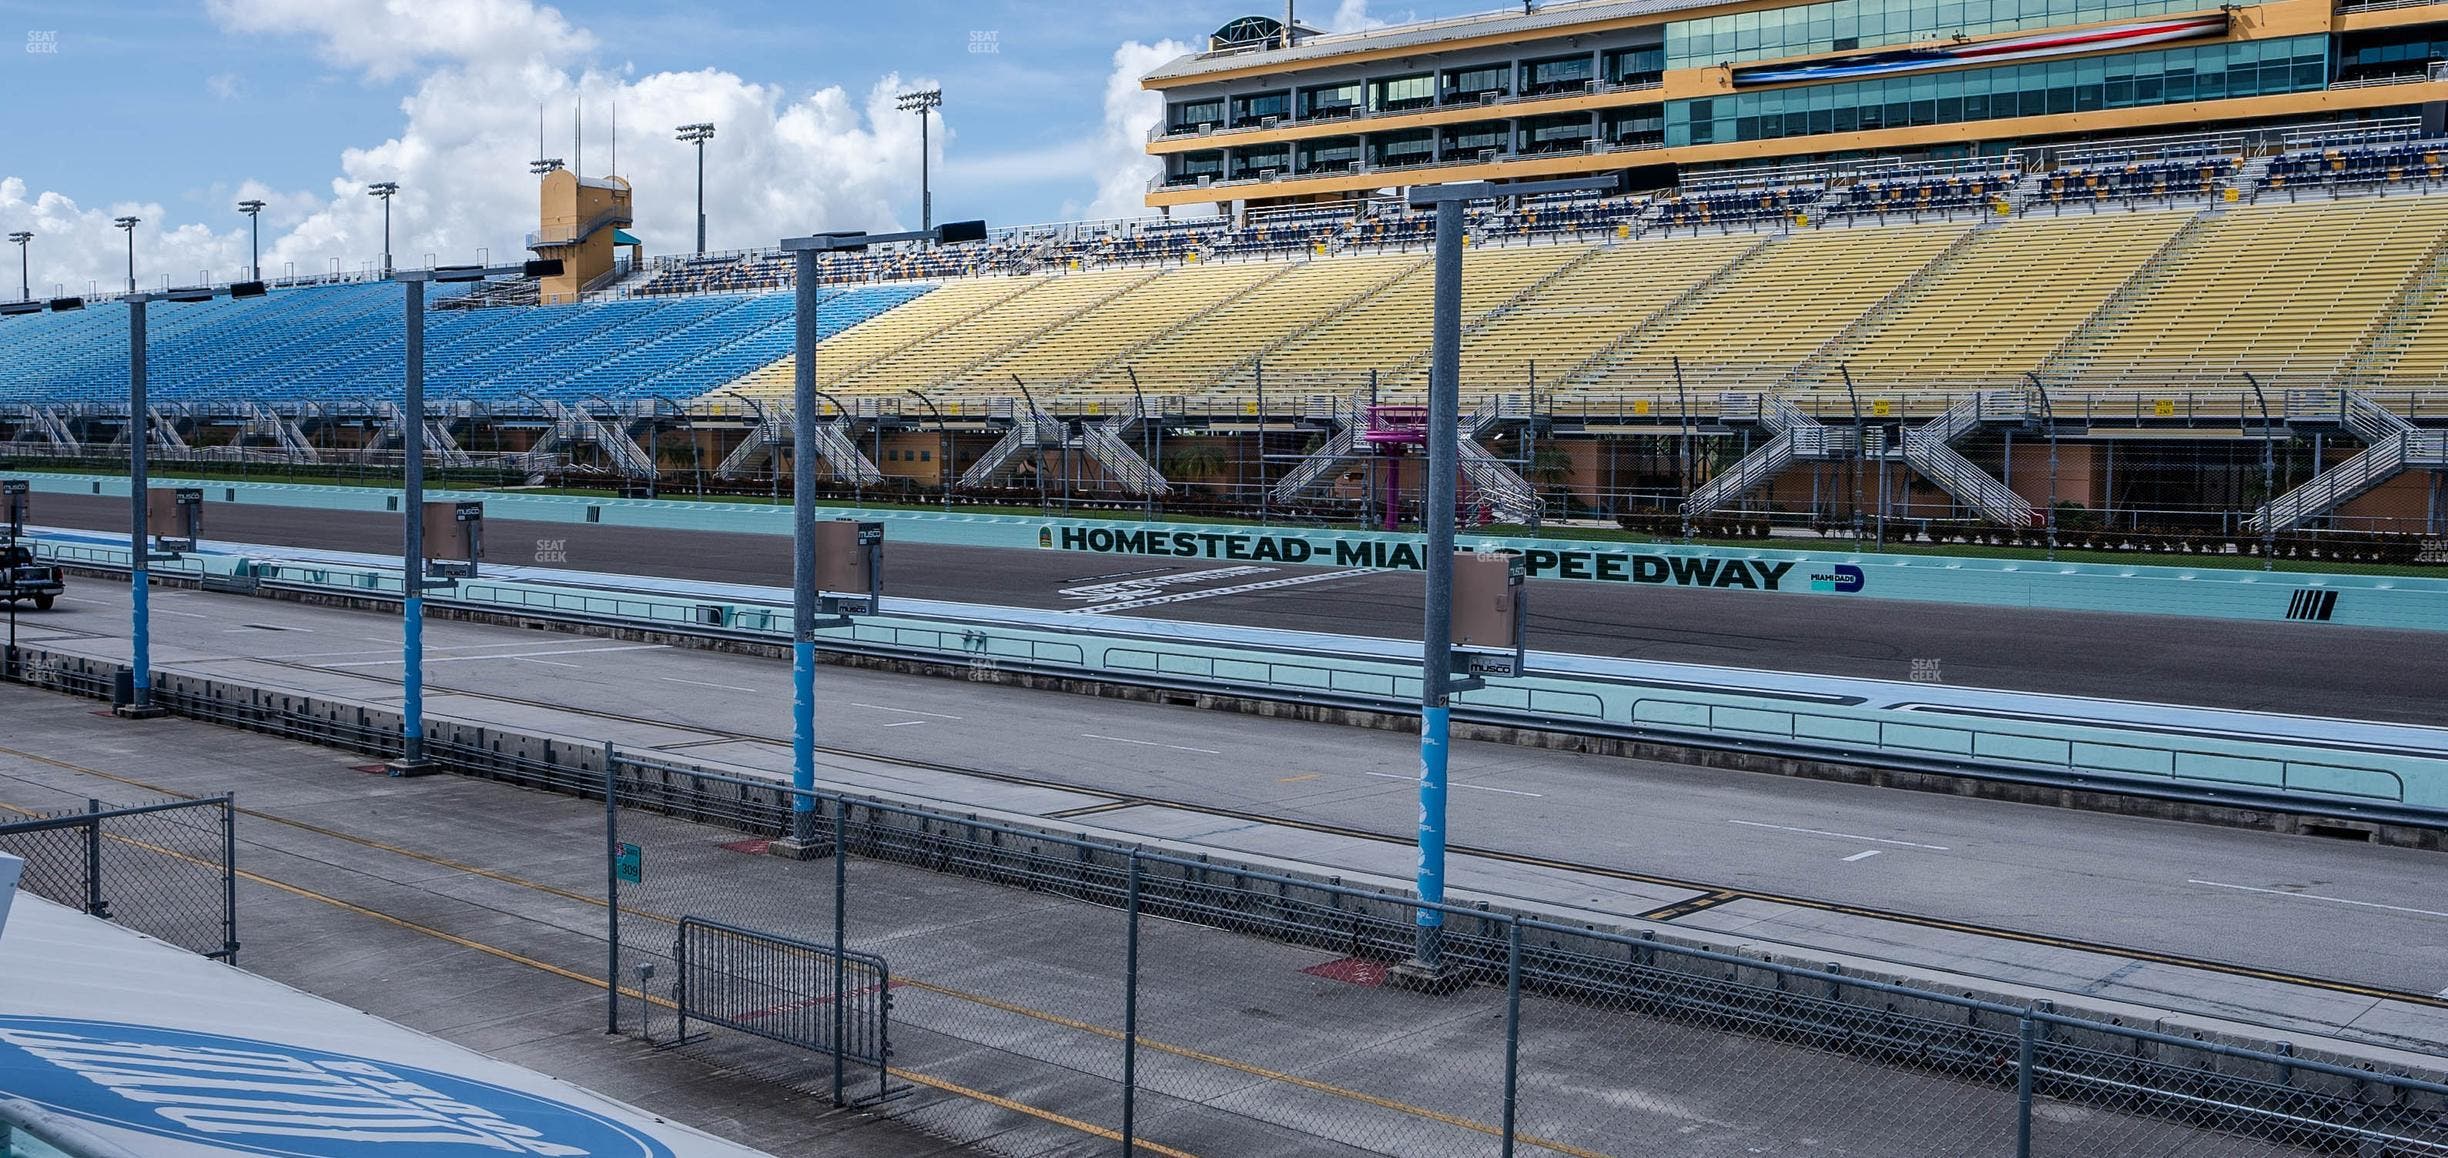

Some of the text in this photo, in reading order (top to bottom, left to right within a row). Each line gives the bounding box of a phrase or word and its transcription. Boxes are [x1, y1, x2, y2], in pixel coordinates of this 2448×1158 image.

[456, 507, 480, 515] musco
[858, 529, 881, 538] musco
[1061, 526, 1796, 591] HOMESTEAD-MIA PEEDWAY
[839, 604, 867, 614] musco
[1470, 663, 1511, 674] musco
[622, 863, 638, 877] 309
